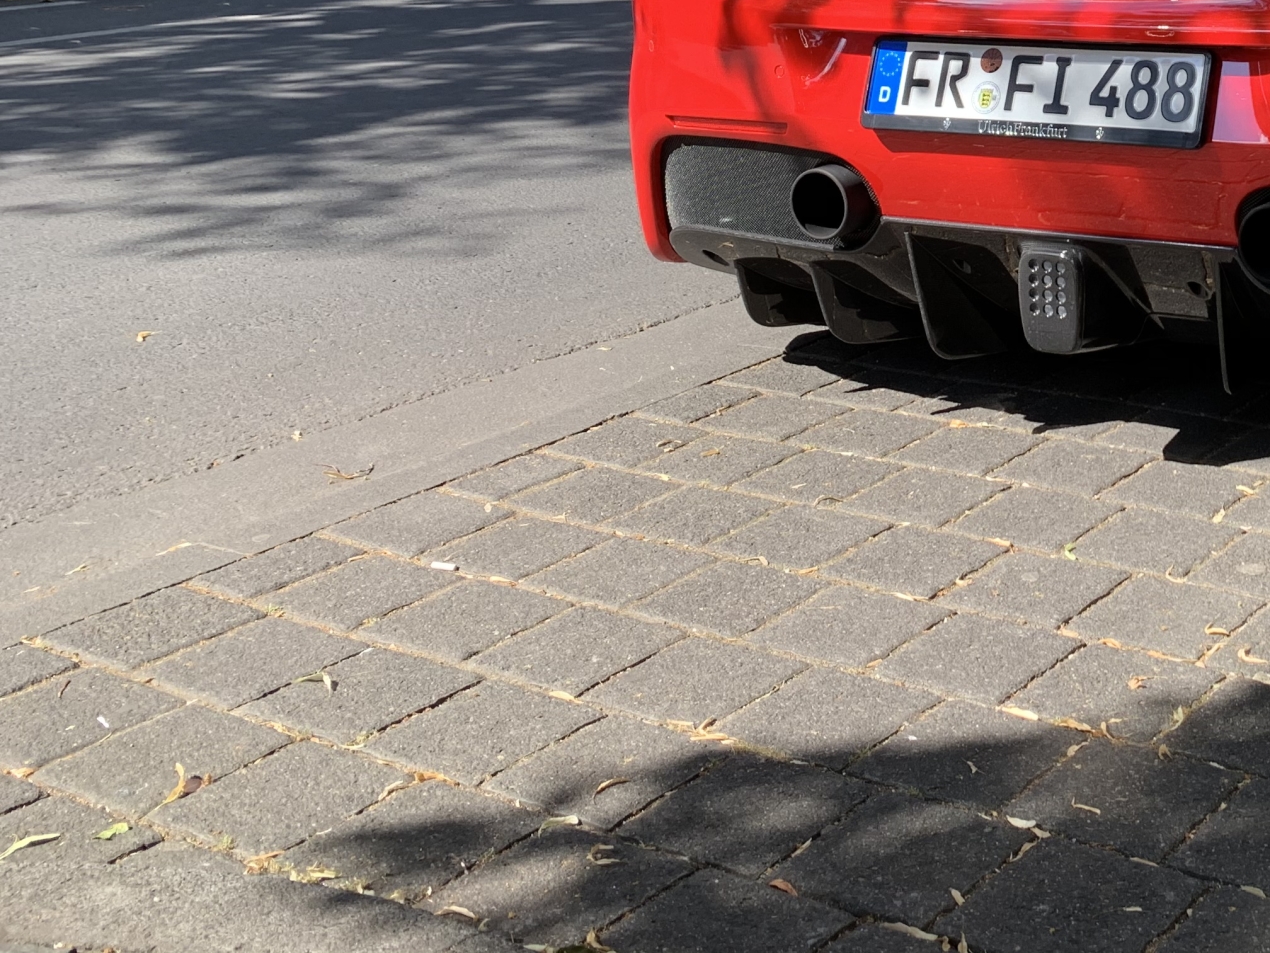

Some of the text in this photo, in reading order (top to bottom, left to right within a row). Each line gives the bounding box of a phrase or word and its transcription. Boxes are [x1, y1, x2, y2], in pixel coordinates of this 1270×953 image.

[878, 86, 891, 103] D
[901, 50, 1198, 123] FR FI 488
